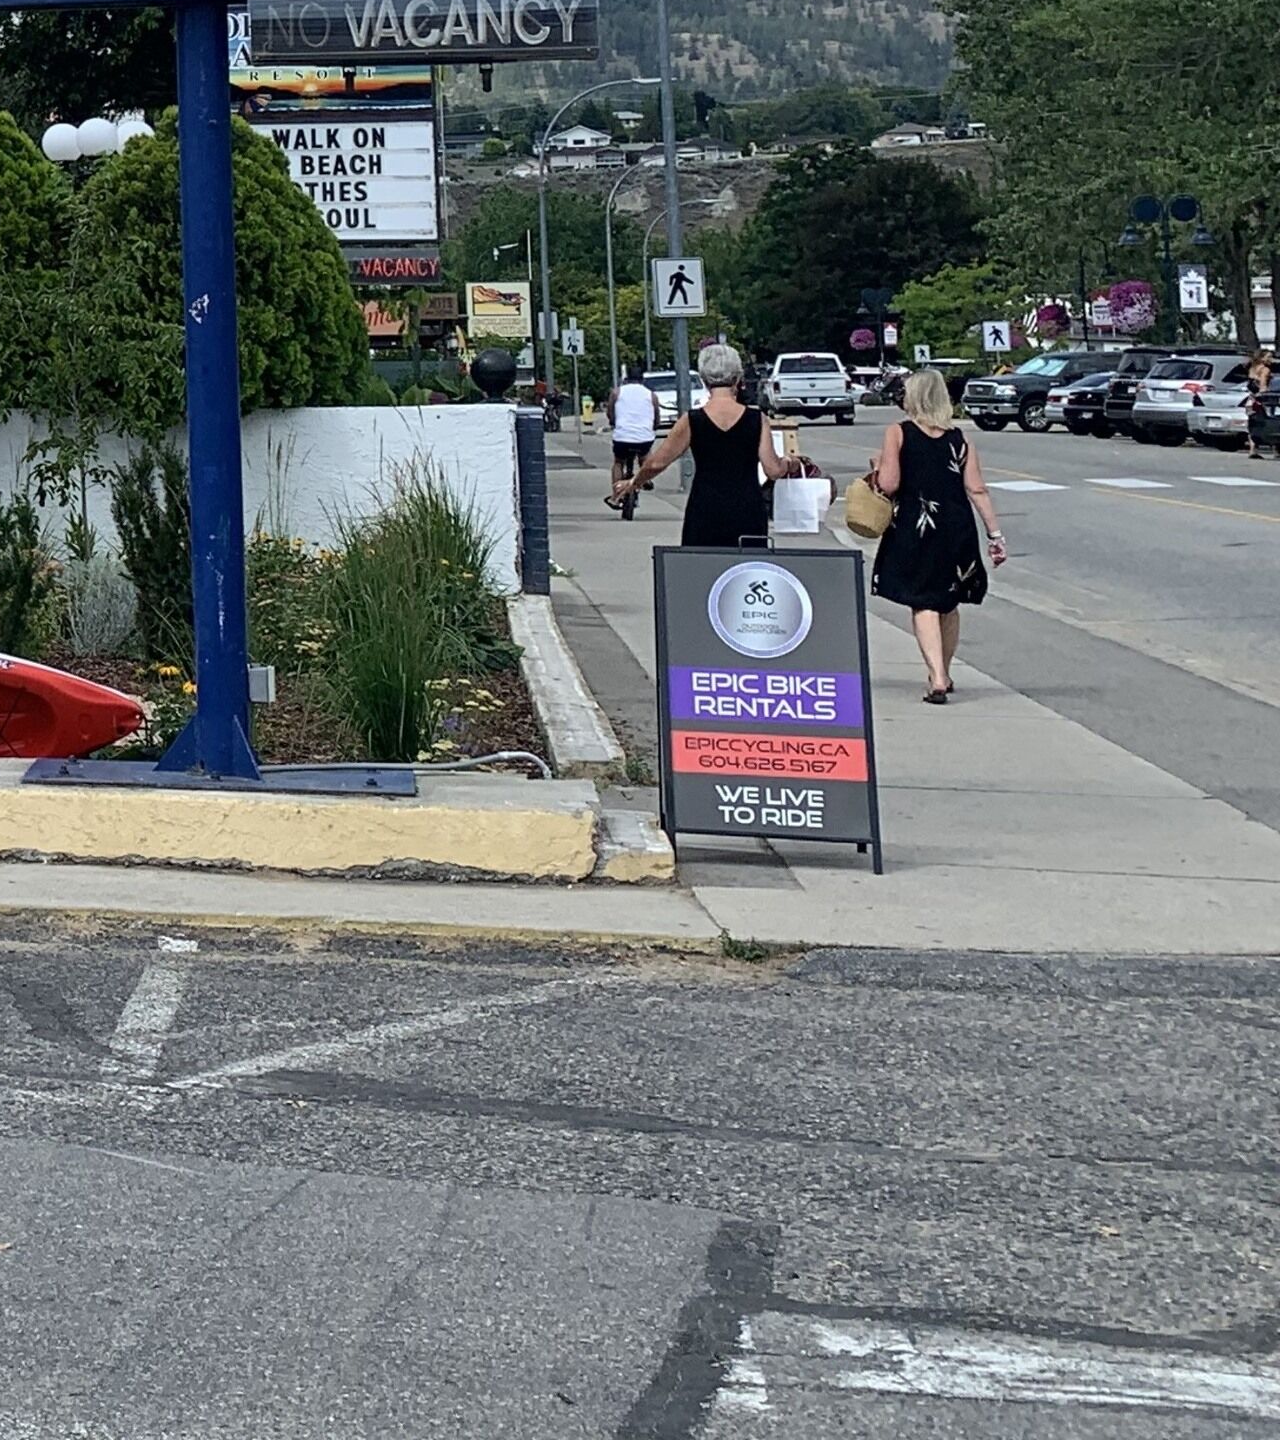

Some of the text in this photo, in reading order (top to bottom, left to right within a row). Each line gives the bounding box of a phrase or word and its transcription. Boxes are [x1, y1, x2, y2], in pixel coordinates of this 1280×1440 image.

[266, 2, 331, 48] NO
[249, 68, 376, 81] RESOT
[272, 127, 386, 149] WALK ON
[301, 154, 382, 176] BEACH
[292, 181, 368, 202] THES
[319, 208, 376, 229] OUL
[361, 257, 438, 277] VACANCY
[741, 610, 779, 620] EPIC
[692, 671, 837, 697] EPIC BIKE
[694, 695, 837, 721] RENTALS
[684, 736, 851, 757] EPICCYCLING.CA
[698, 755, 838, 774] 604.626.5167
[715, 784, 825, 808] WE LIVE
[718, 805, 824, 828] TO RIDE
